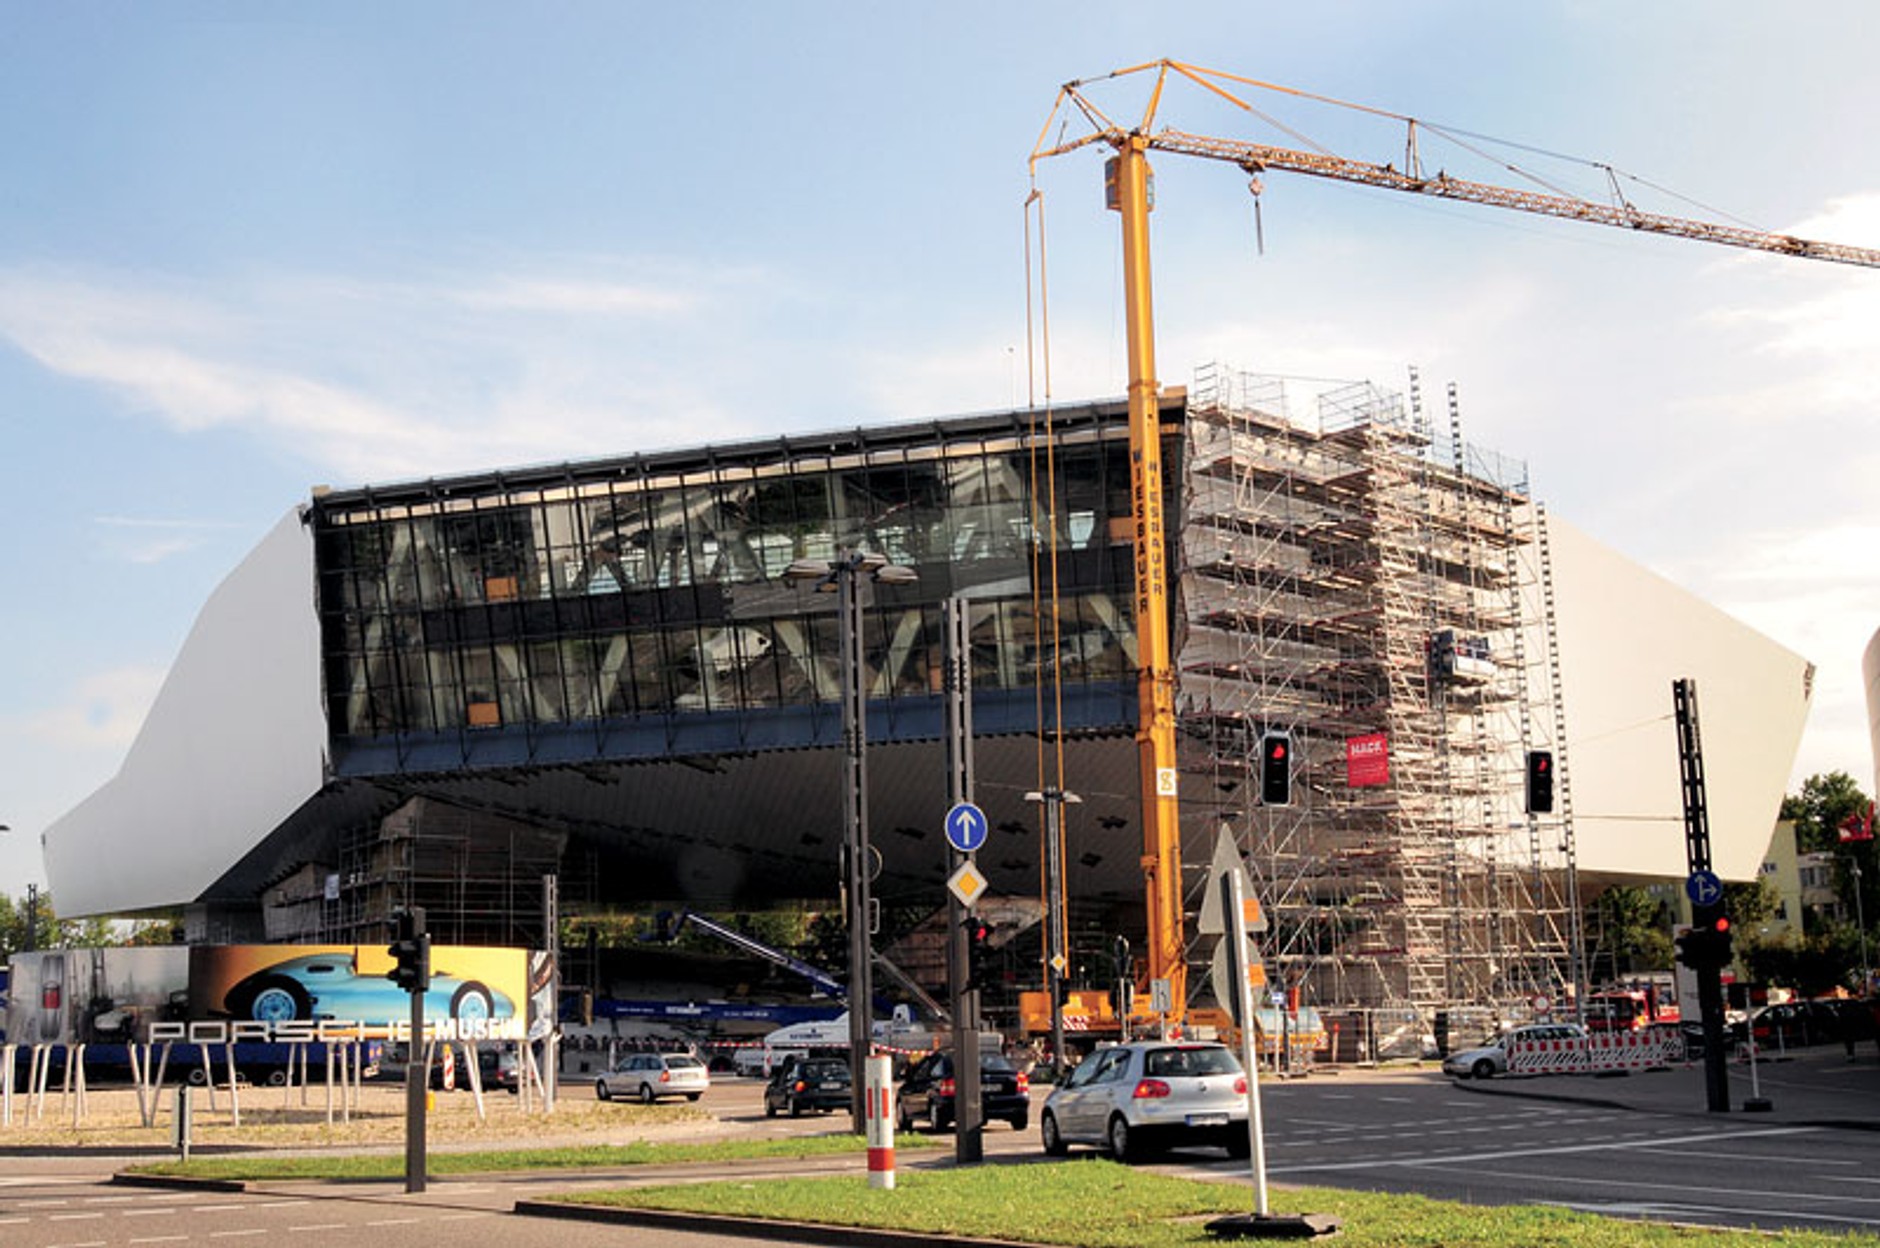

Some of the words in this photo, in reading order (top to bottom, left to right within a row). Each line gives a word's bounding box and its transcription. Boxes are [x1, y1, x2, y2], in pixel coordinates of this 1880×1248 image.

[1133, 450, 1148, 613] WIESBAUER
[149, 1019, 434, 1044] PORSCHE
[434, 1018, 527, 1041] MUSEUM
